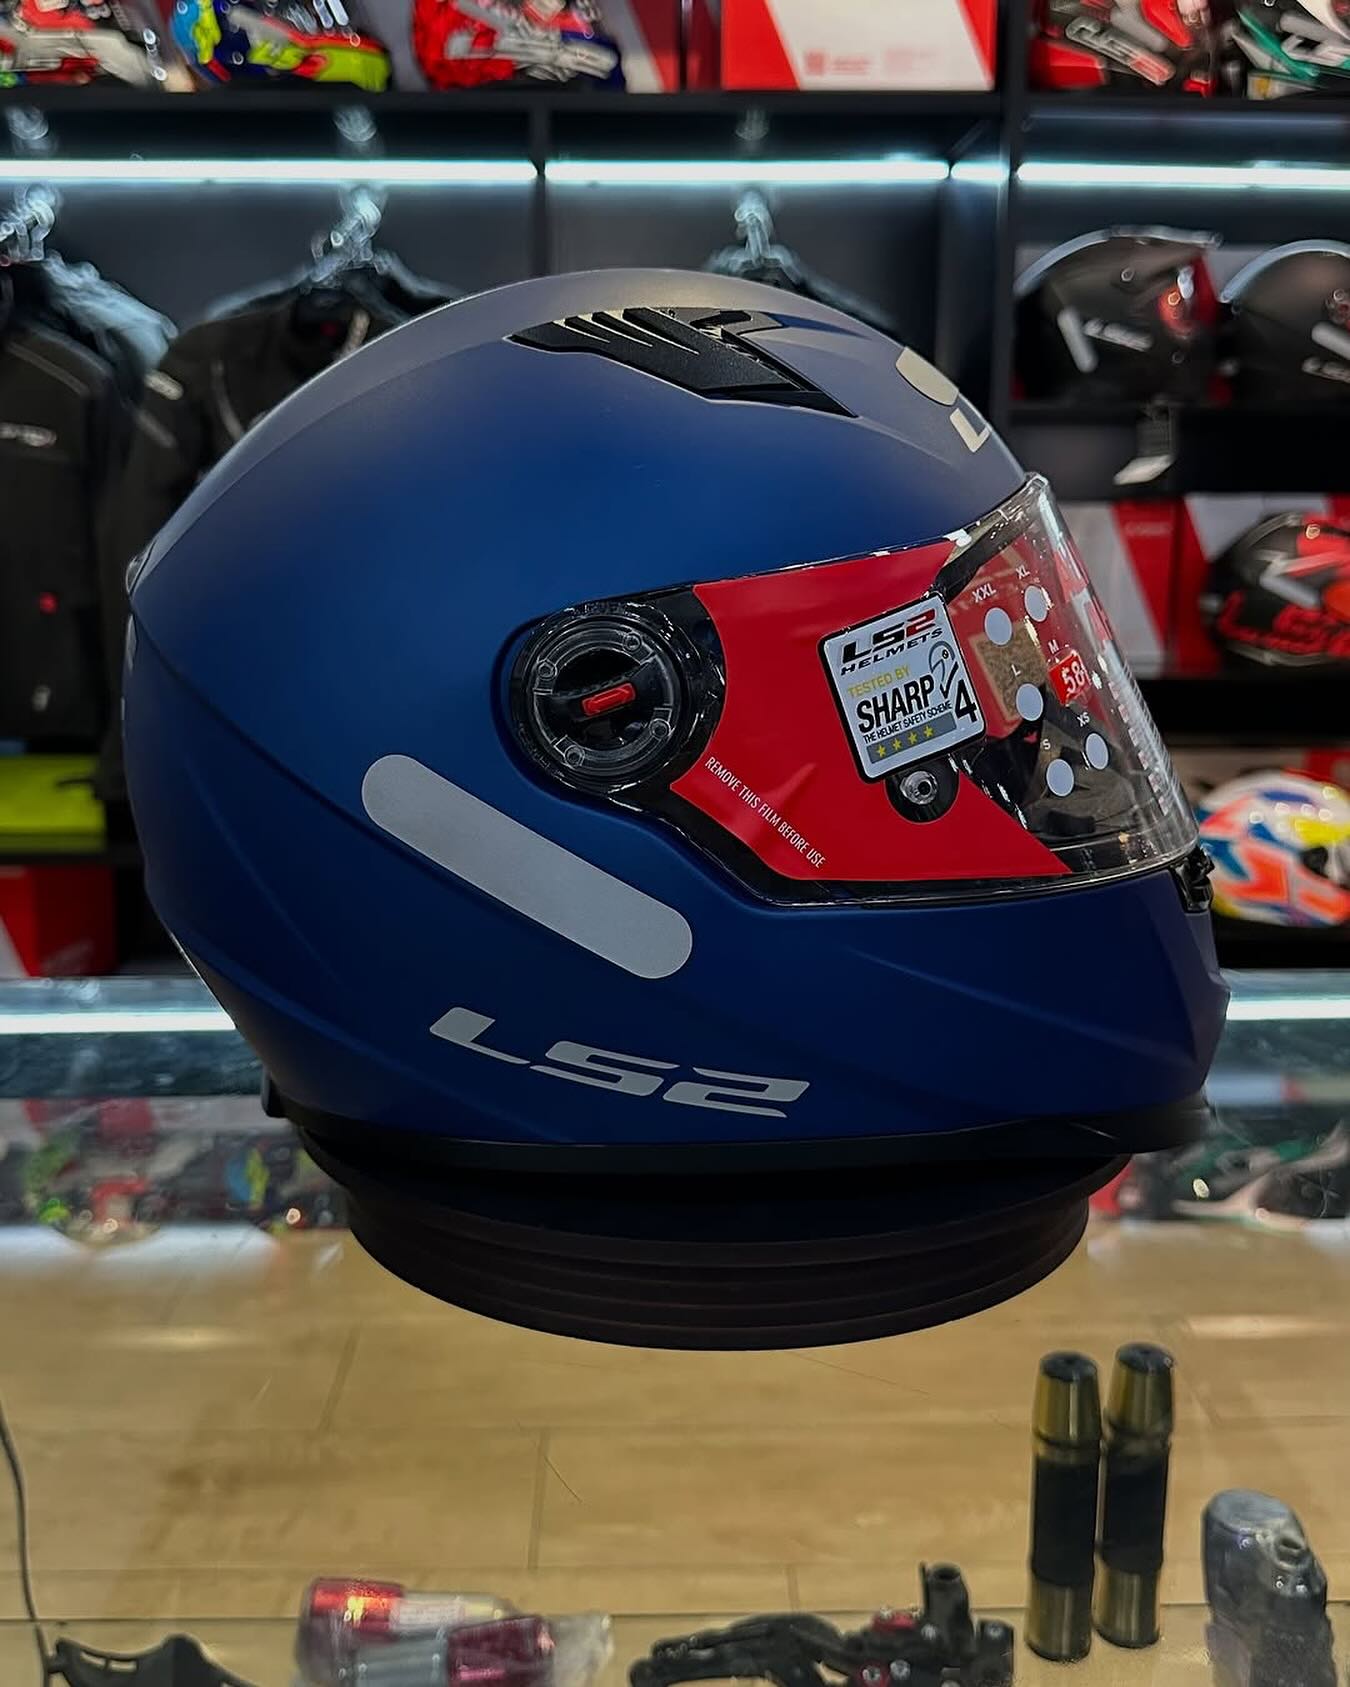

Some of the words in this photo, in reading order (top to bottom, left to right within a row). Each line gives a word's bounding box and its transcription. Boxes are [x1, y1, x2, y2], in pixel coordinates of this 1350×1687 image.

[1015, 565, 1031, 581] XL
[971, 583, 997, 603] XXL
[840, 627, 943, 676] HELMETS
[842, 608, 937, 664] LS2
[1048, 639, 1060, 654] M
[847, 673, 893, 698] TESTED
[895, 664, 911, 682] BY
[1011, 664, 1021, 677] L
[856, 674, 935, 734] SHARP
[955, 679, 978, 723] 4
[1077, 711, 1091, 728] XS
[863, 730, 877, 744] THE
[877, 721, 902, 739] HELMET
[903, 710, 927, 729] SAFETY
[926, 699, 953, 719] SCHEME
[1042, 739, 1051, 750] S
[704, 756, 742, 792] REMOVE
[738, 784, 761, 809] THIS
[757, 803, 782, 827] FILM
[777, 821, 810, 854] BEFORE
[805, 848, 826, 869] USE
[429, 1006, 811, 1118] LS2
